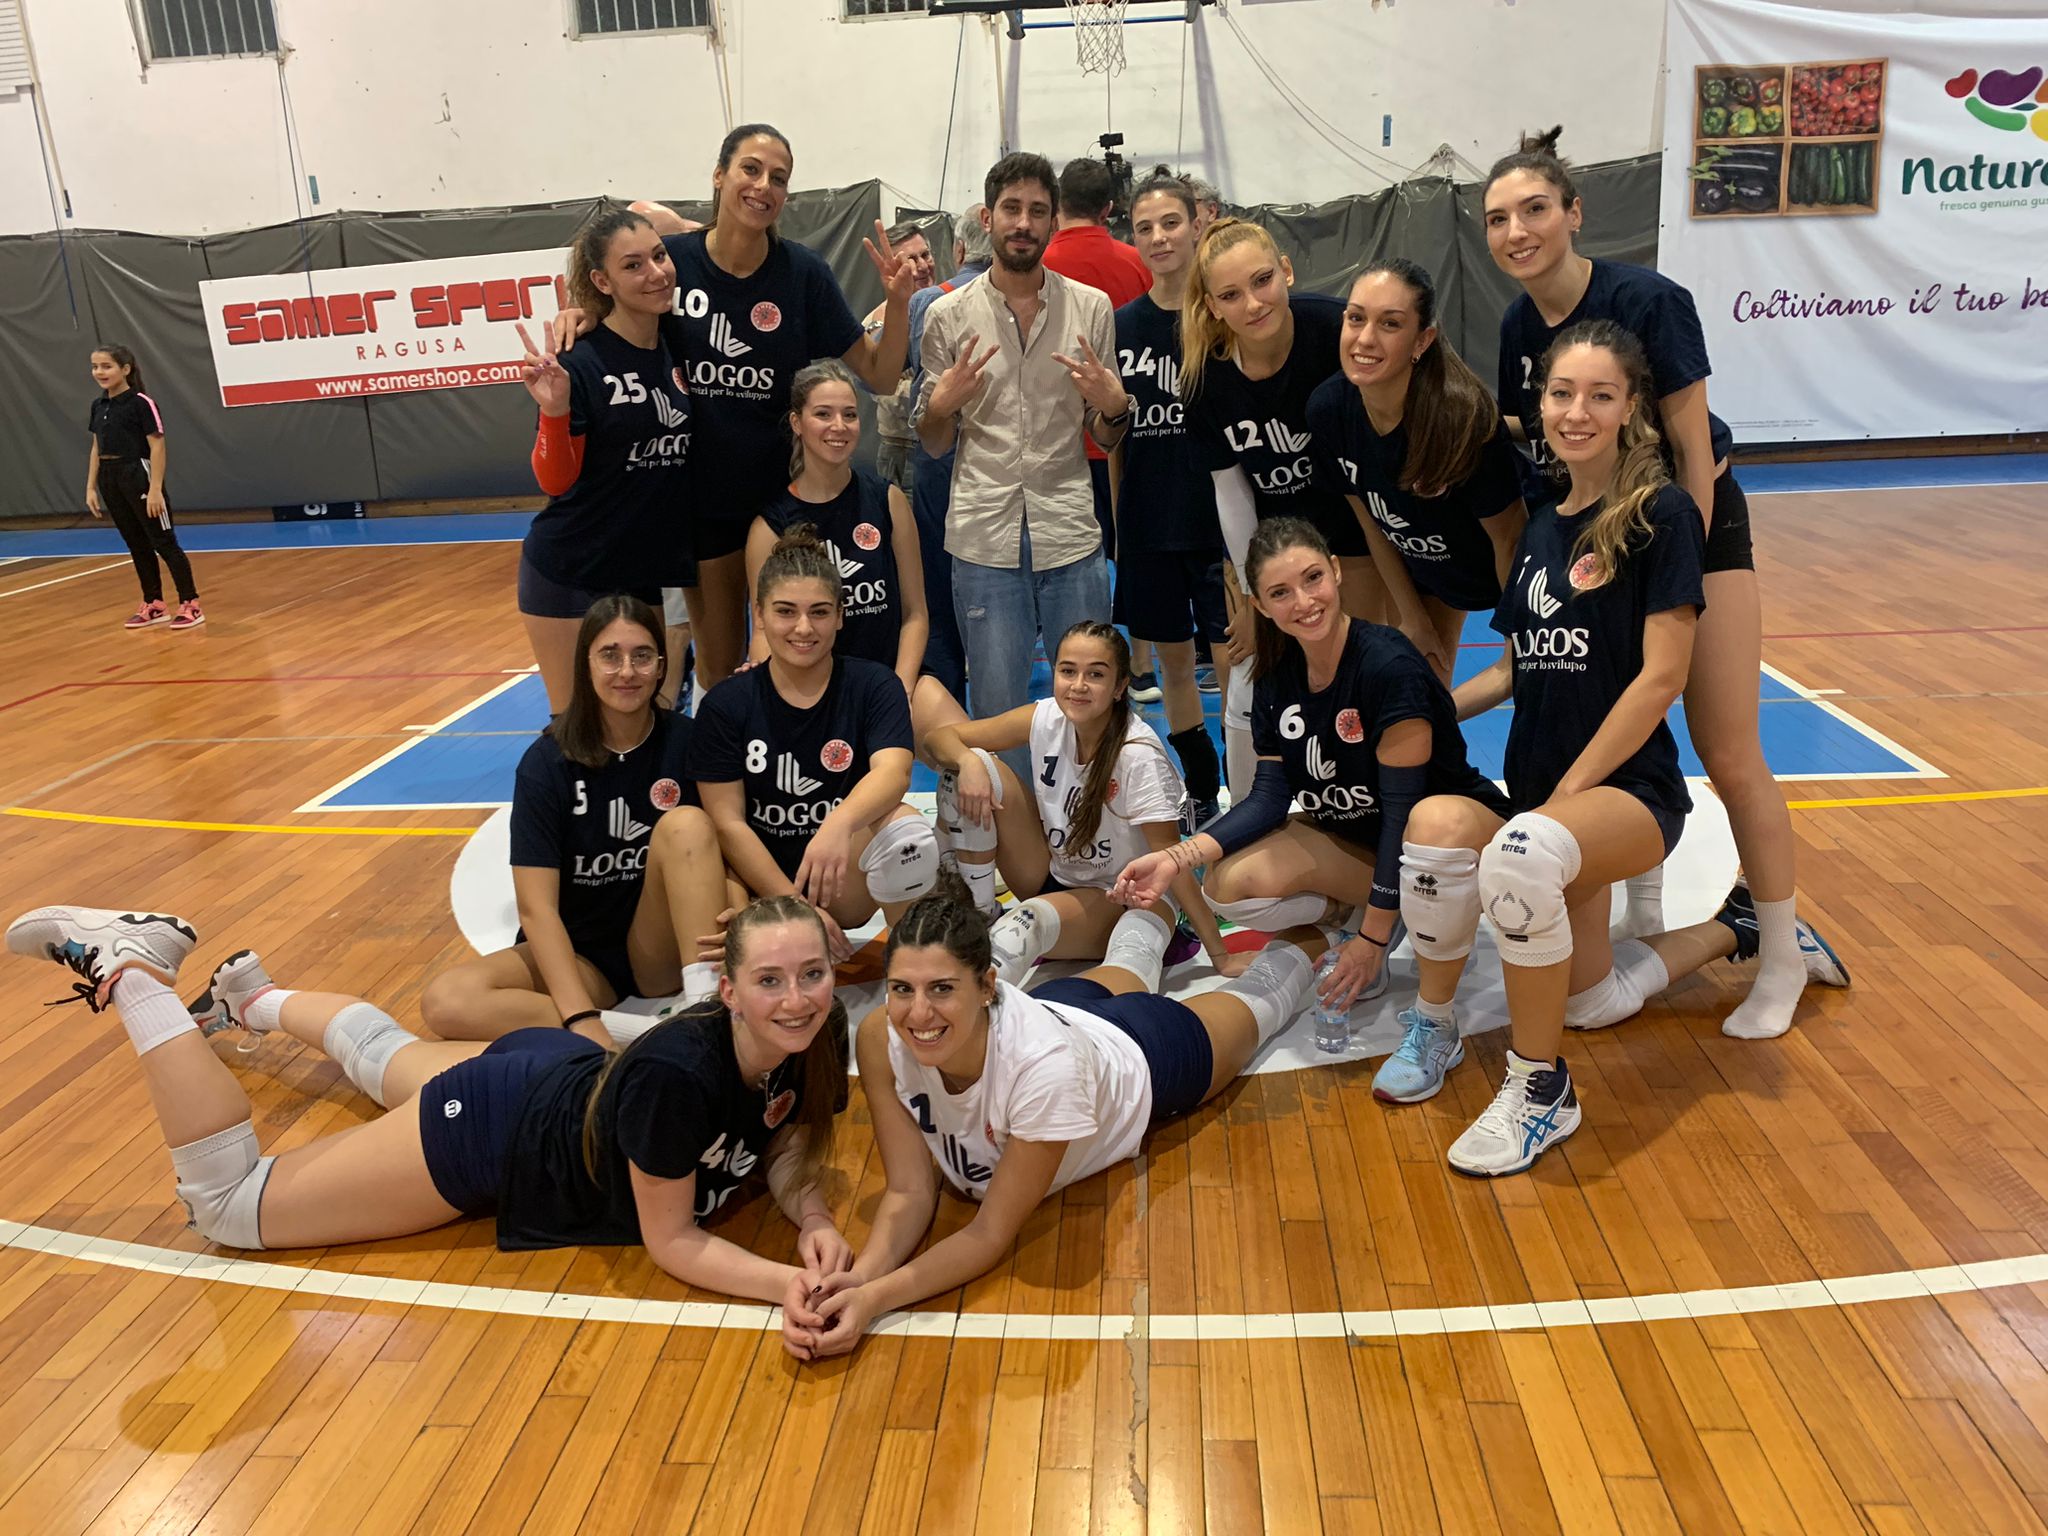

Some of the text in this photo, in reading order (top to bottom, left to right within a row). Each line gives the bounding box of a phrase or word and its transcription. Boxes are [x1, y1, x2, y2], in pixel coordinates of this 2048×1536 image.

[1940, 201, 1977, 211] fresca
[1980, 198, 2028, 212] genuina
[1733, 289, 1896, 323] Coltiviamo
[1908, 283, 1942, 314] il
[1953, 283, 2010, 311] tuo
[356, 336, 466, 360] RAGUSA
[1119, 346, 1156, 377] 24
[316, 363, 521, 396] www.samershop.com
[603, 372, 648, 405] 25
[685, 360, 775, 390] LOGOS
[709, 388, 724, 398] per
[726, 388, 734, 397] lo
[735, 390, 771, 401] sviluppo
[1133, 403, 1184, 428] LOG
[1132, 428, 1158, 438] servizi
[1159, 427, 1171, 437] per
[1252, 456, 1312, 489] LOG
[1382, 530, 1447, 553] GOS
[842, 579, 886, 607] GOS
[1279, 704, 1306, 740] 6
[745, 739, 768, 774] 8
[1040, 755, 1059, 788] 1
[573, 780, 588, 815] 5
[779, 829, 797, 838] per
[799, 828, 808, 836] lo
[574, 845, 650, 877] LOGO
[1501, 843, 1527, 855] errea
[1413, 885, 1438, 896] errea
